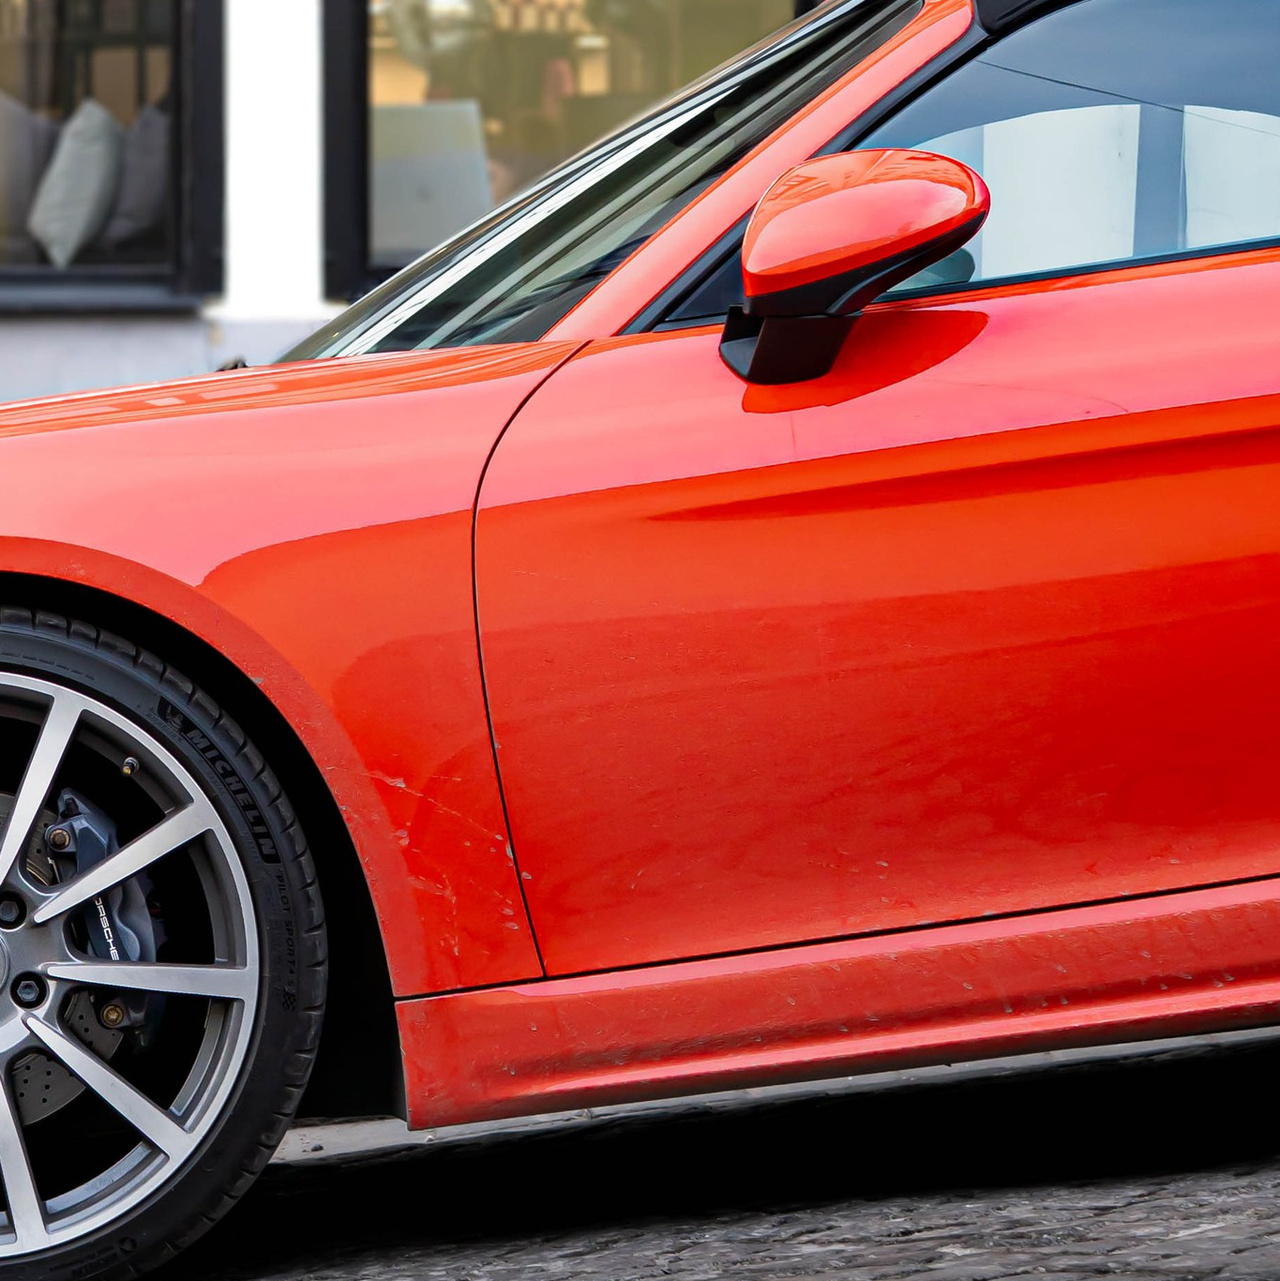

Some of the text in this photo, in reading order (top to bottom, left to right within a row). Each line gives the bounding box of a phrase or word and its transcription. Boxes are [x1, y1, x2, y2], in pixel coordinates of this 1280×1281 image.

[185, 728, 277, 857] MICHELIN
[275, 874, 291, 913] PILOT
[94, 897, 120, 961] ORSCHE
